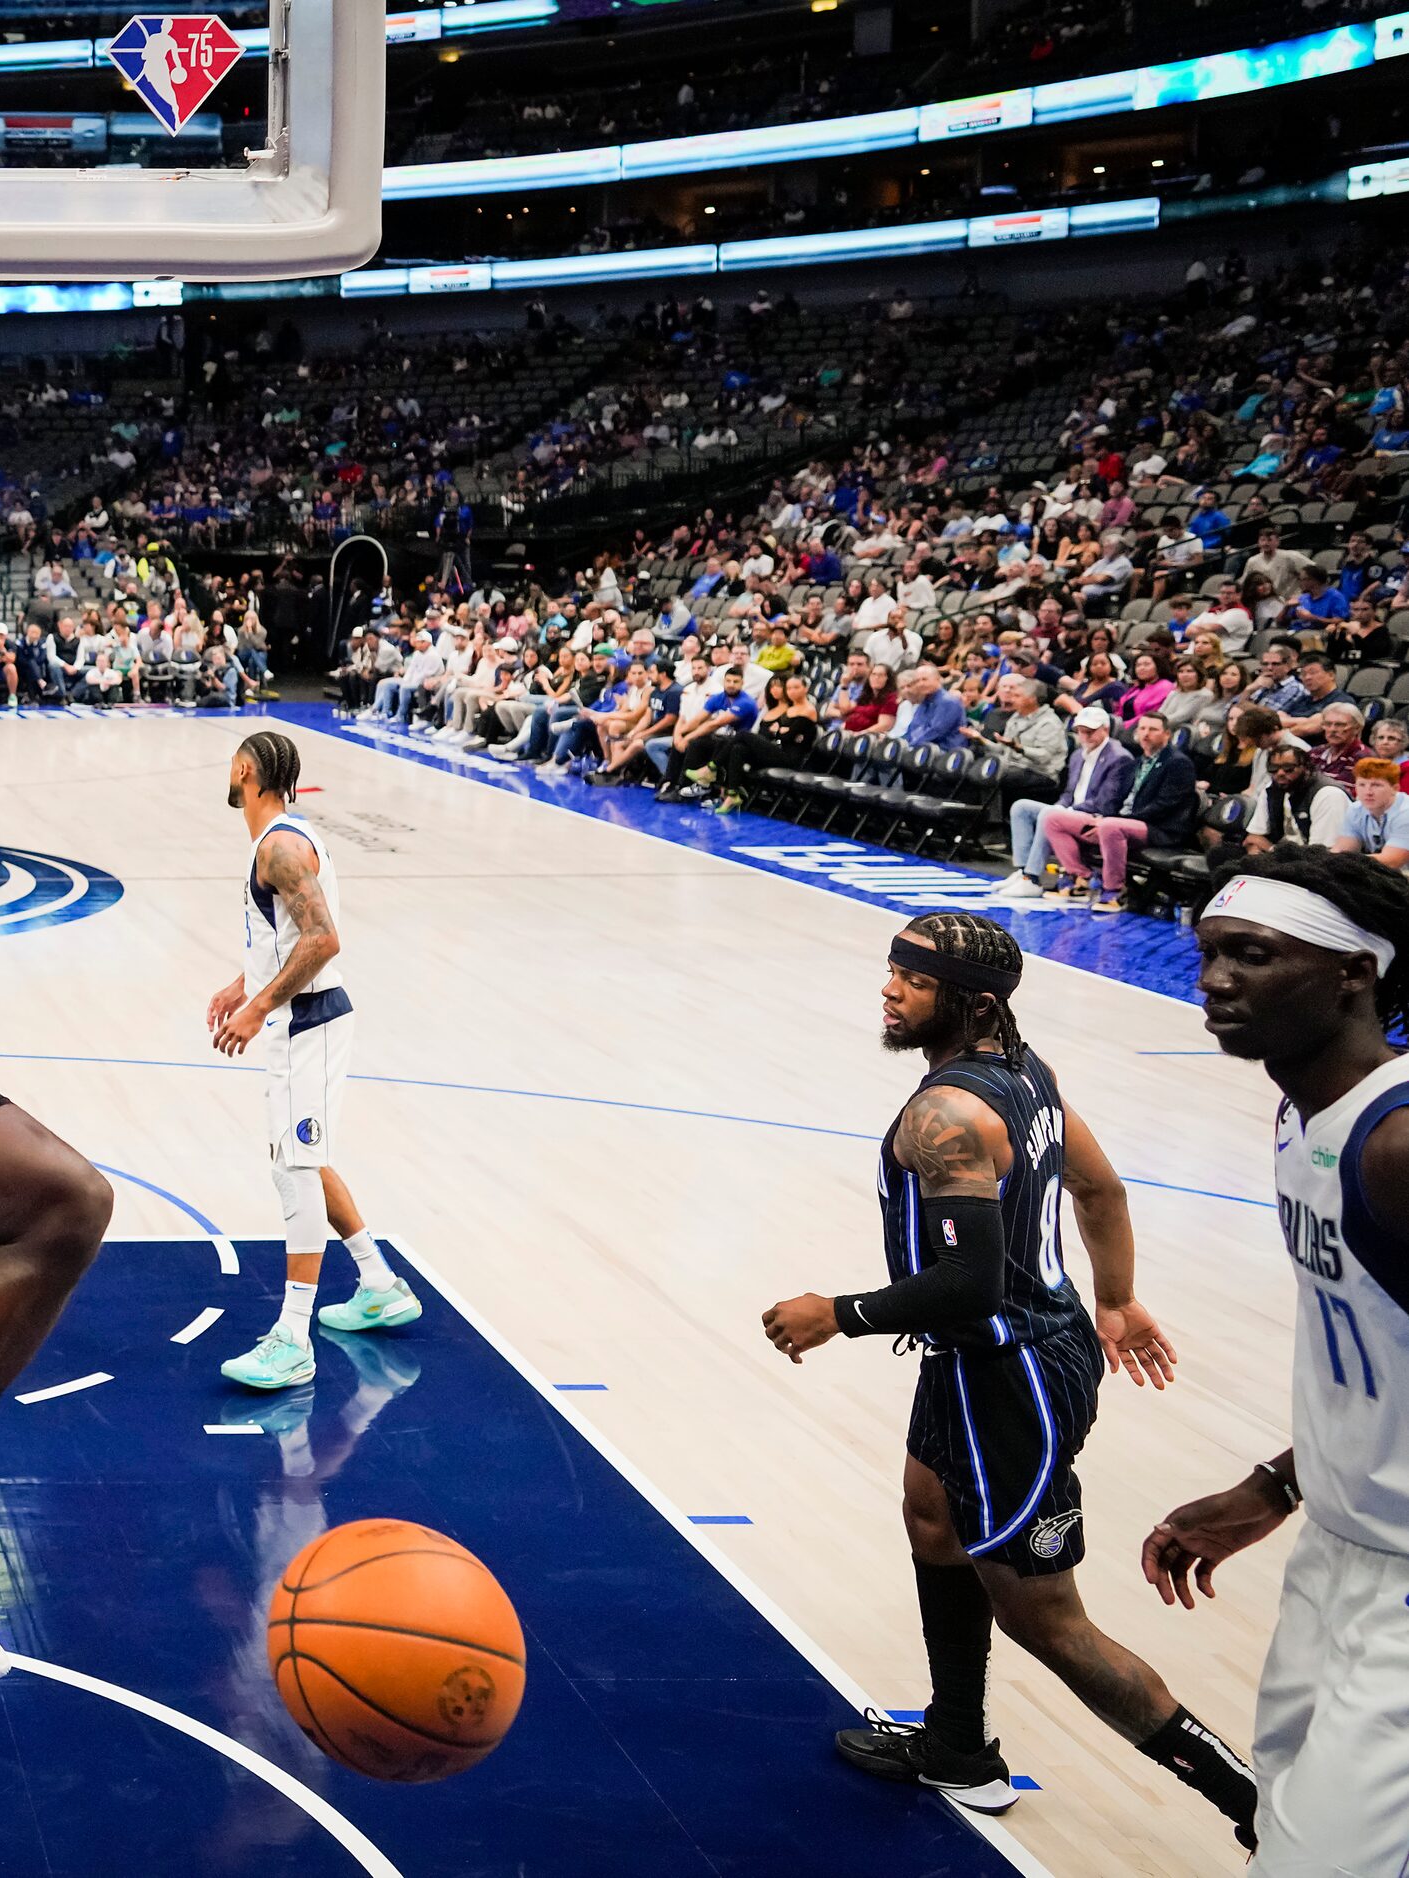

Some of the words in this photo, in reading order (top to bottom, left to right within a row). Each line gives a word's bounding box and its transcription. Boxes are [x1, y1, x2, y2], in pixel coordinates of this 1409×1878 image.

[188, 33, 214, 68] 75
[1026, 1105, 1063, 1170] SIMPSON
[1039, 1174, 1066, 1290] 8
[1313, 1283, 1379, 1402] 17
